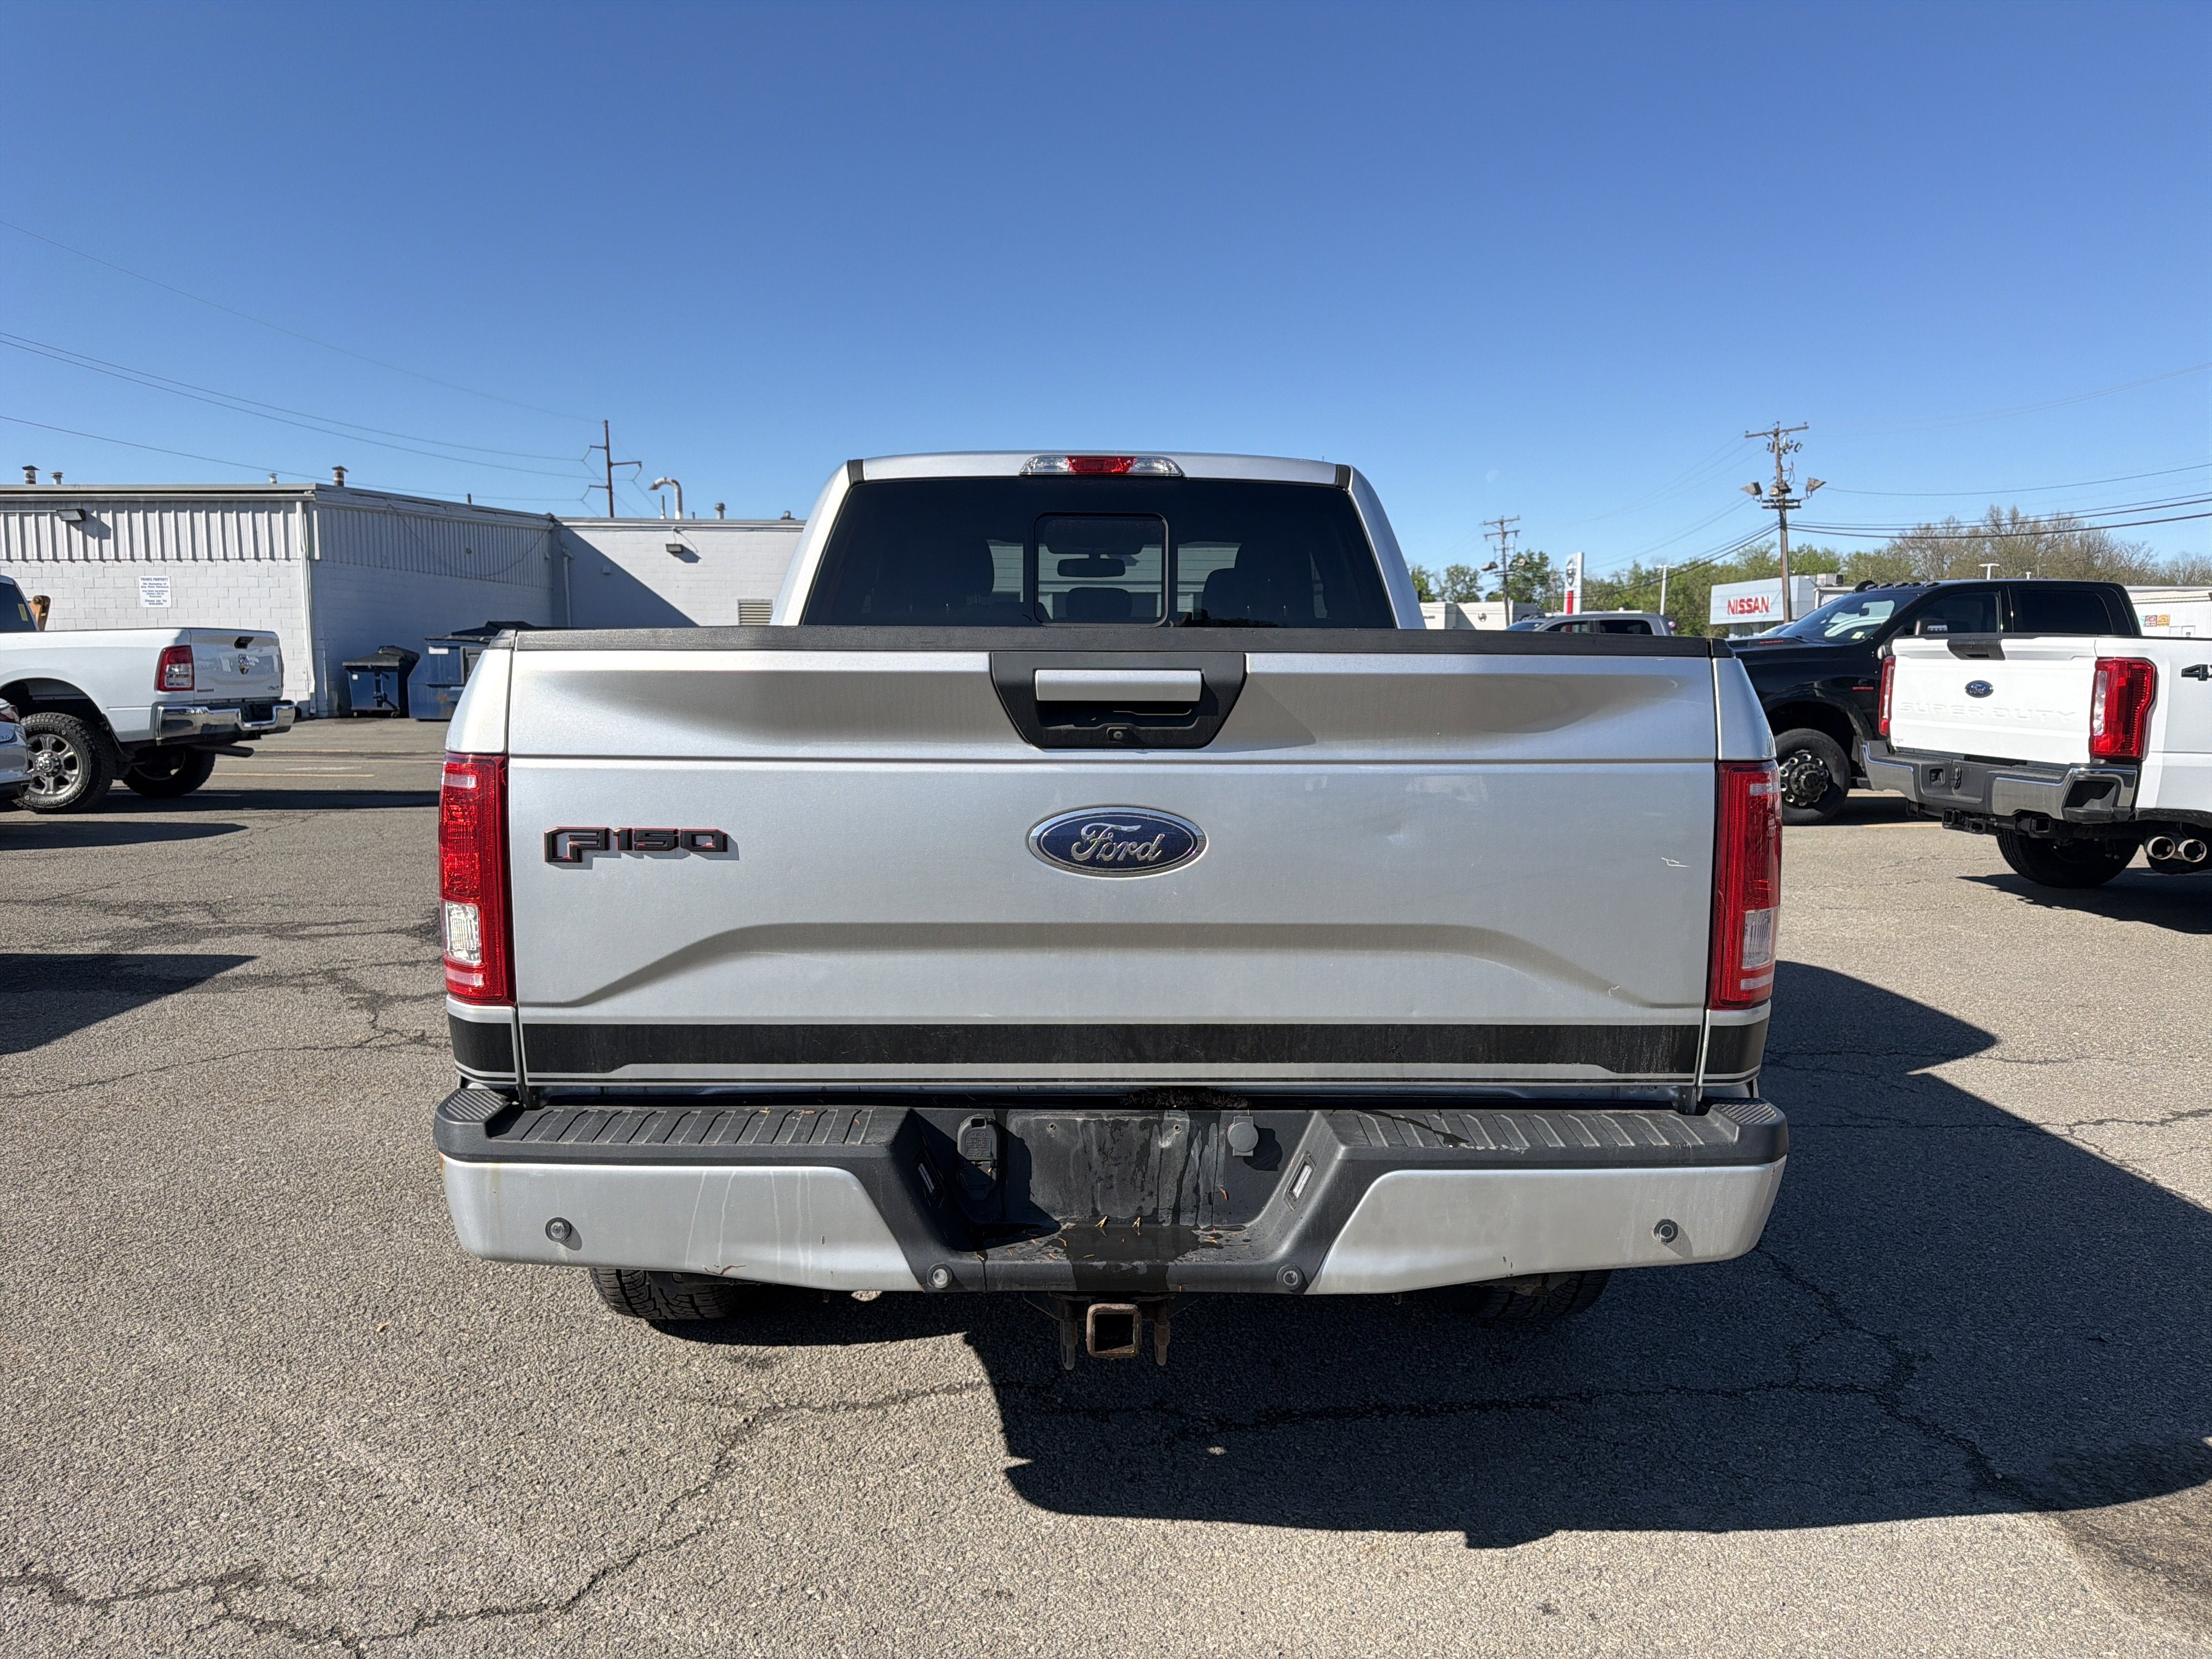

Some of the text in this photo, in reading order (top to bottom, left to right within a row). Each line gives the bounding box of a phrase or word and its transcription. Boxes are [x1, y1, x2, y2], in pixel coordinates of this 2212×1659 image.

[1727, 596, 1770, 615] NISSAN
[1969, 684, 1986, 695] Ford
[1900, 702, 2076, 723] SUPER DUTY
[1071, 822, 1166, 861] Ford
